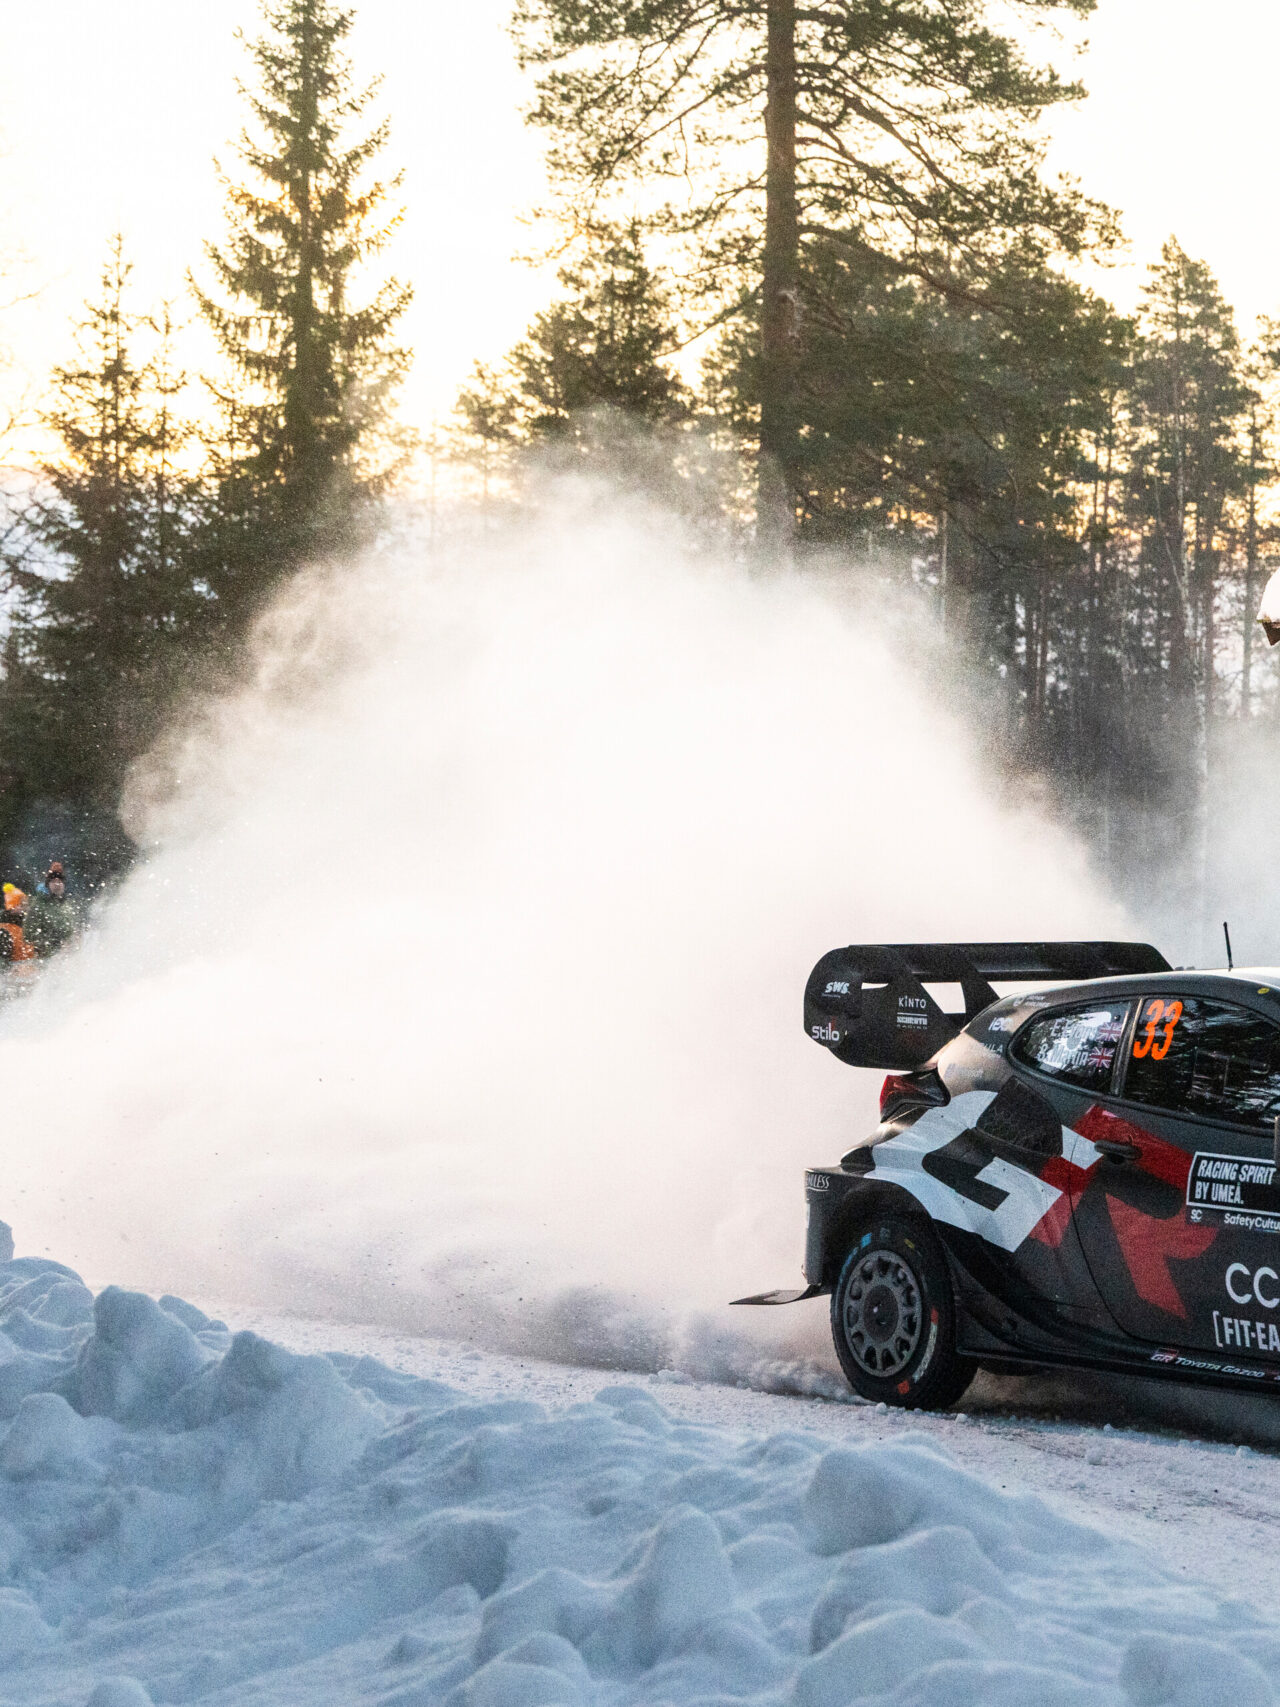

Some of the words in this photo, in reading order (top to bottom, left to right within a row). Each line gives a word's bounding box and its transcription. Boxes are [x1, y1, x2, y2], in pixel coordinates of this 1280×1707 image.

[811, 1022, 840, 1041] Stilo
[1133, 1000, 1183, 1060] 33
[1197, 1159, 1239, 1181] RACING
[1238, 1163, 1277, 1185] SPIRIT
[1195, 1181, 1209, 1200] BY
[1175, 1357, 1221, 1371] TOYOTA
